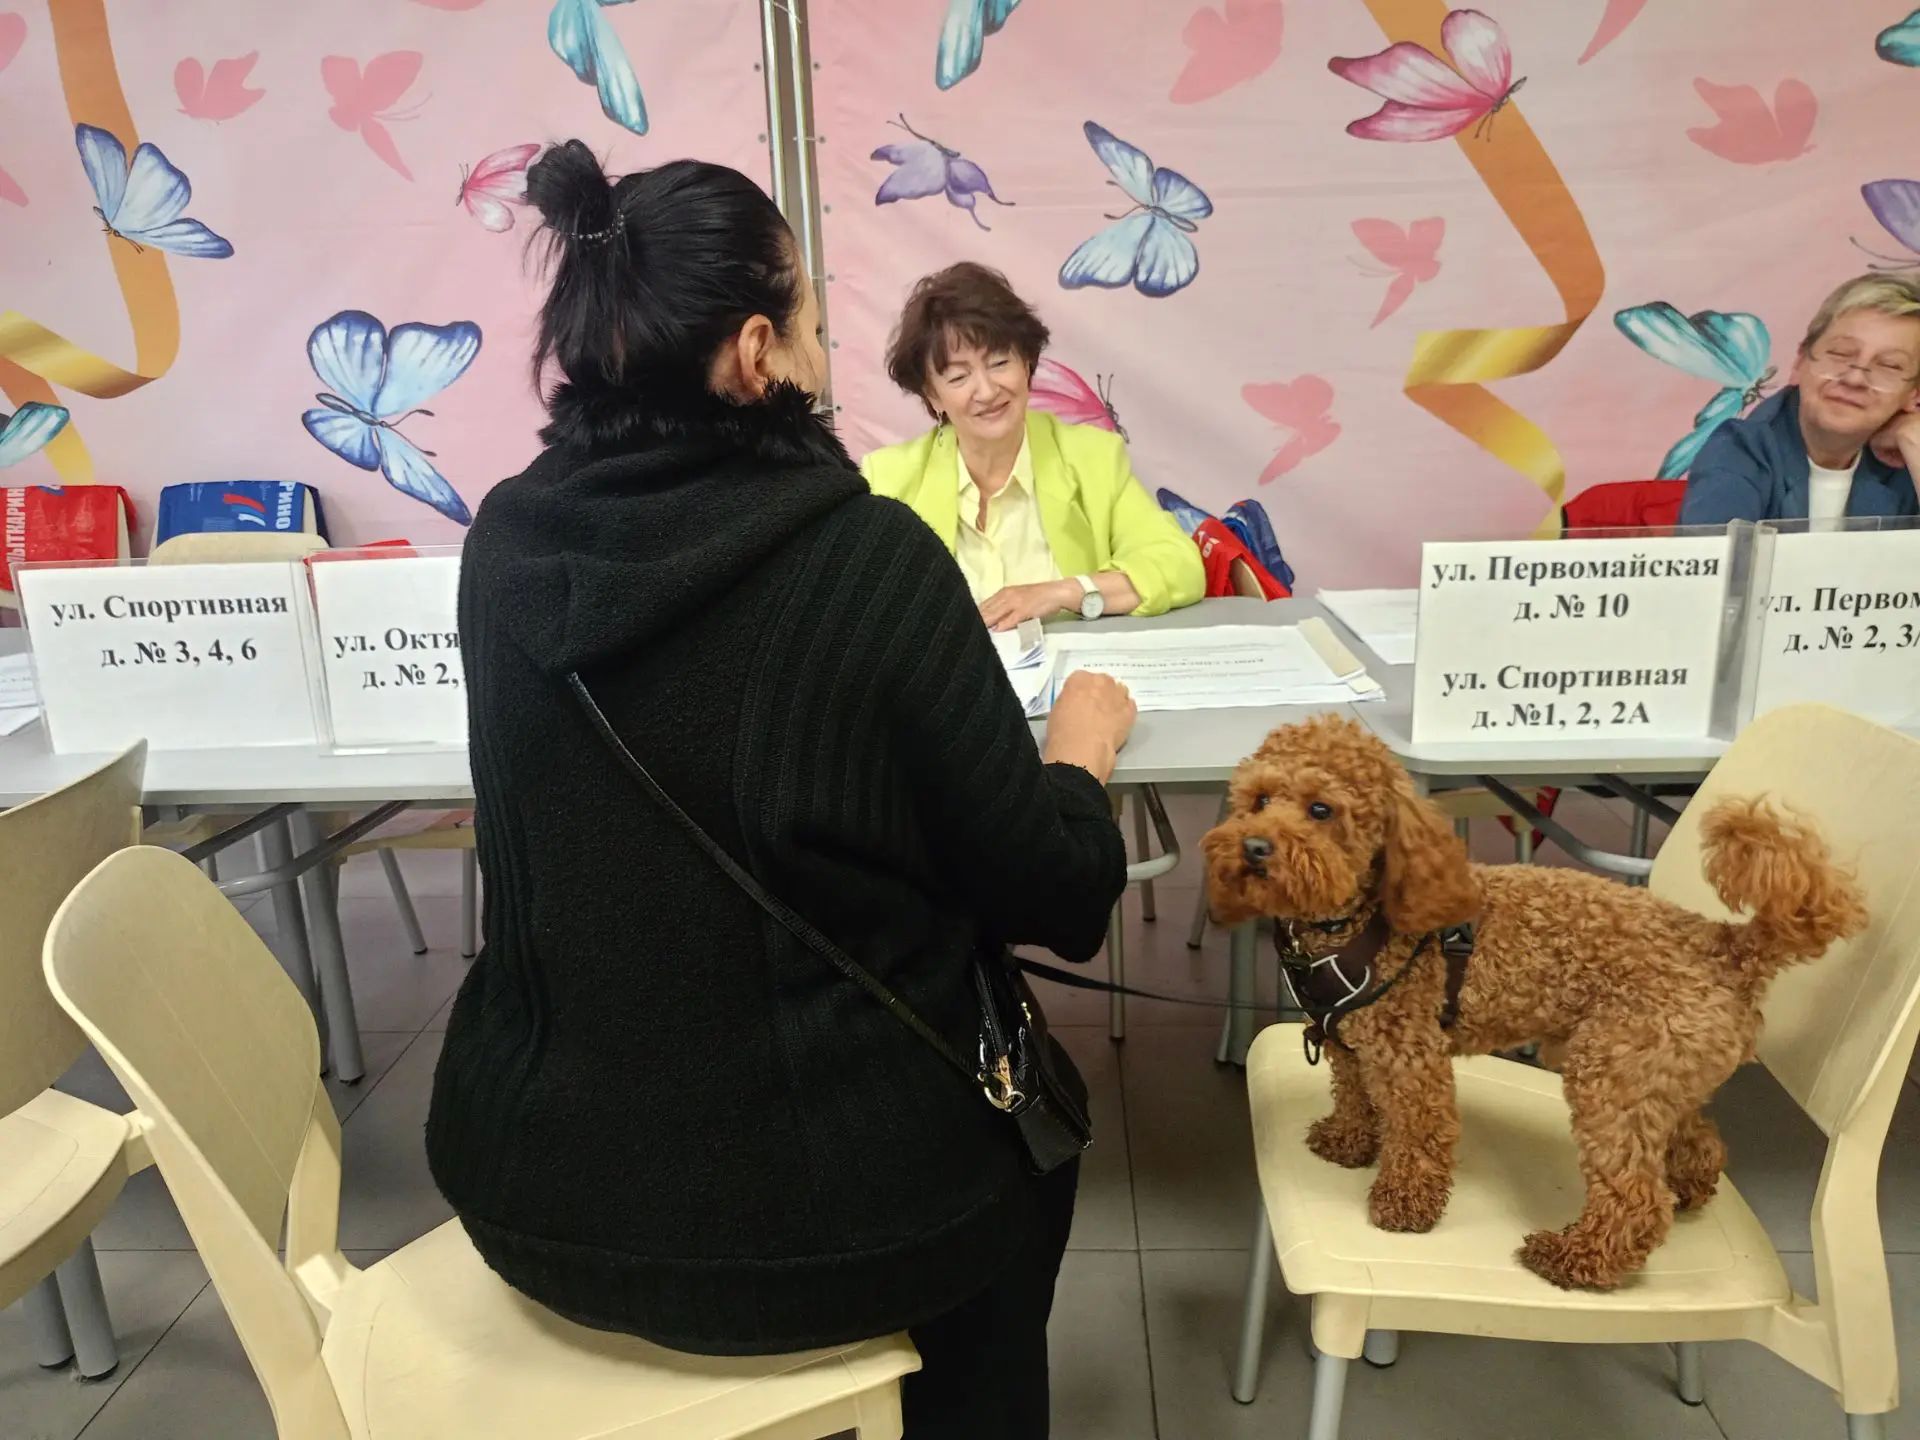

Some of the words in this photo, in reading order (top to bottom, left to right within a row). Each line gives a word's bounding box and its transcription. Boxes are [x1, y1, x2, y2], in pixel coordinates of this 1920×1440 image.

[1431, 563, 1475, 589] ул.
[1488, 553, 1719, 587] Первомайская
[50, 602, 95, 627] ул.
[103, 595, 288, 623] Спортивная
[1513, 601, 1540, 623] д.
[1550, 593, 1585, 618] №
[1596, 592, 1629, 618] 10
[101, 649, 125, 668] д.
[134, 641, 166, 665] №
[175, 640, 200, 667] 3,
[208, 639, 234, 666] 4,
[241, 638, 257, 661] 6
[333, 635, 376, 659] ул.
[384, 627, 459, 651] Октя
[1782, 634, 1809, 654] д.
[1818, 626, 1853, 650] №
[1862, 625, 1887, 653] 2,
[362, 671, 386, 690] д.
[394, 664, 426, 686] №
[434, 662, 459, 689] 2,
[1441, 672, 1487, 697] ул.
[1497, 664, 1688, 695] Спортивная
[1471, 711, 1497, 729] д.
[1506, 702, 1566, 730] №1,
[1577, 702, 1600, 728] 2,
[1611, 701, 1650, 725] 2А
